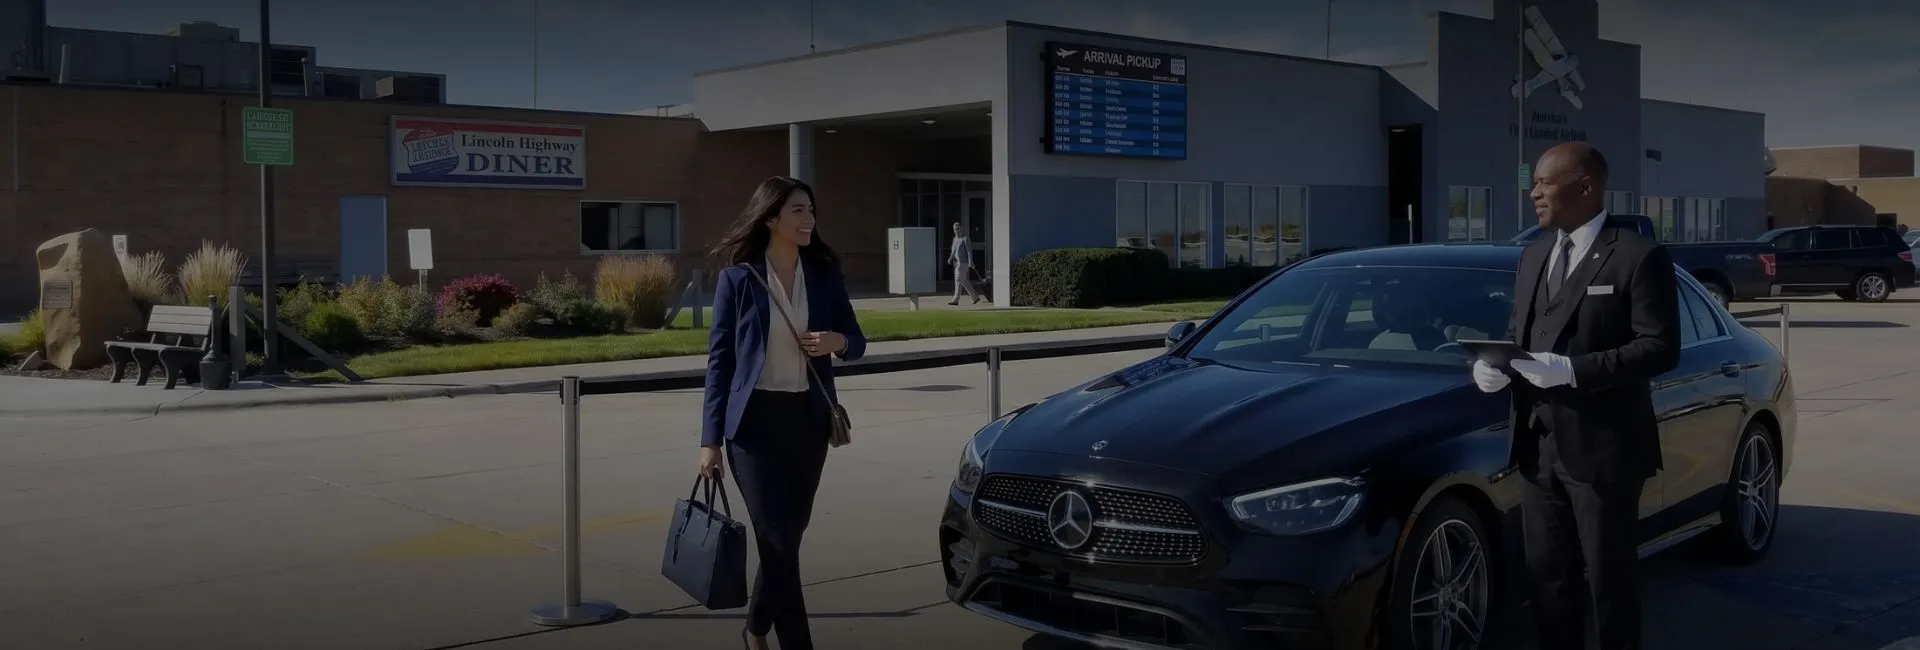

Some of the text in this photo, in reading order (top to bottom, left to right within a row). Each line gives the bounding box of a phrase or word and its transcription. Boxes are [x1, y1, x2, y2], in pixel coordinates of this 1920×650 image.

[1083, 50, 1161, 69] ARRIVAL PICKUP
[461, 134, 578, 154] Lincoln Highway
[466, 153, 576, 175] DINER
